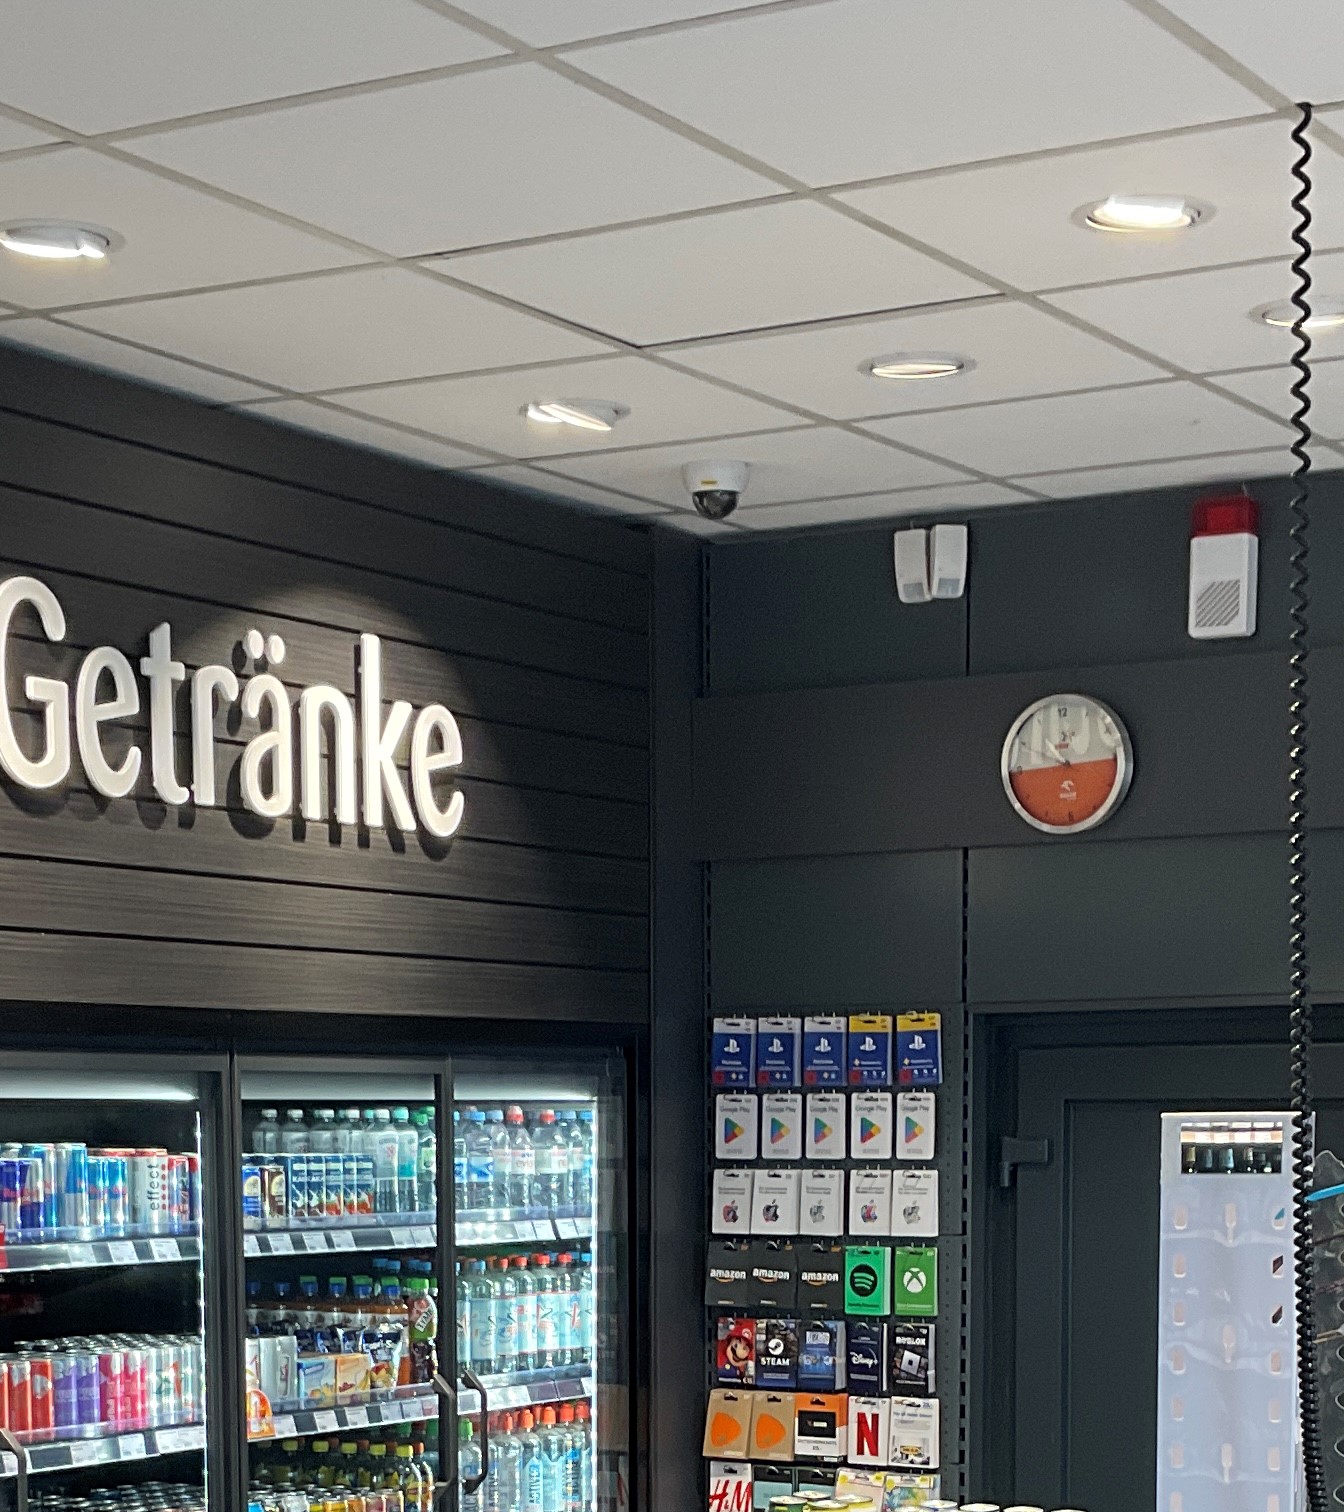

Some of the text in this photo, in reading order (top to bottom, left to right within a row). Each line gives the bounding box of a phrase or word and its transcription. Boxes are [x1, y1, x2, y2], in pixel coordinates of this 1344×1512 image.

[149, 1162, 161, 1213] effect
[710, 1268, 747, 1280] amazon
[752, 1268, 790, 1281] amazon
[801, 1272, 839, 1283] amazon
[760, 1357, 791, 1367] STEAM
